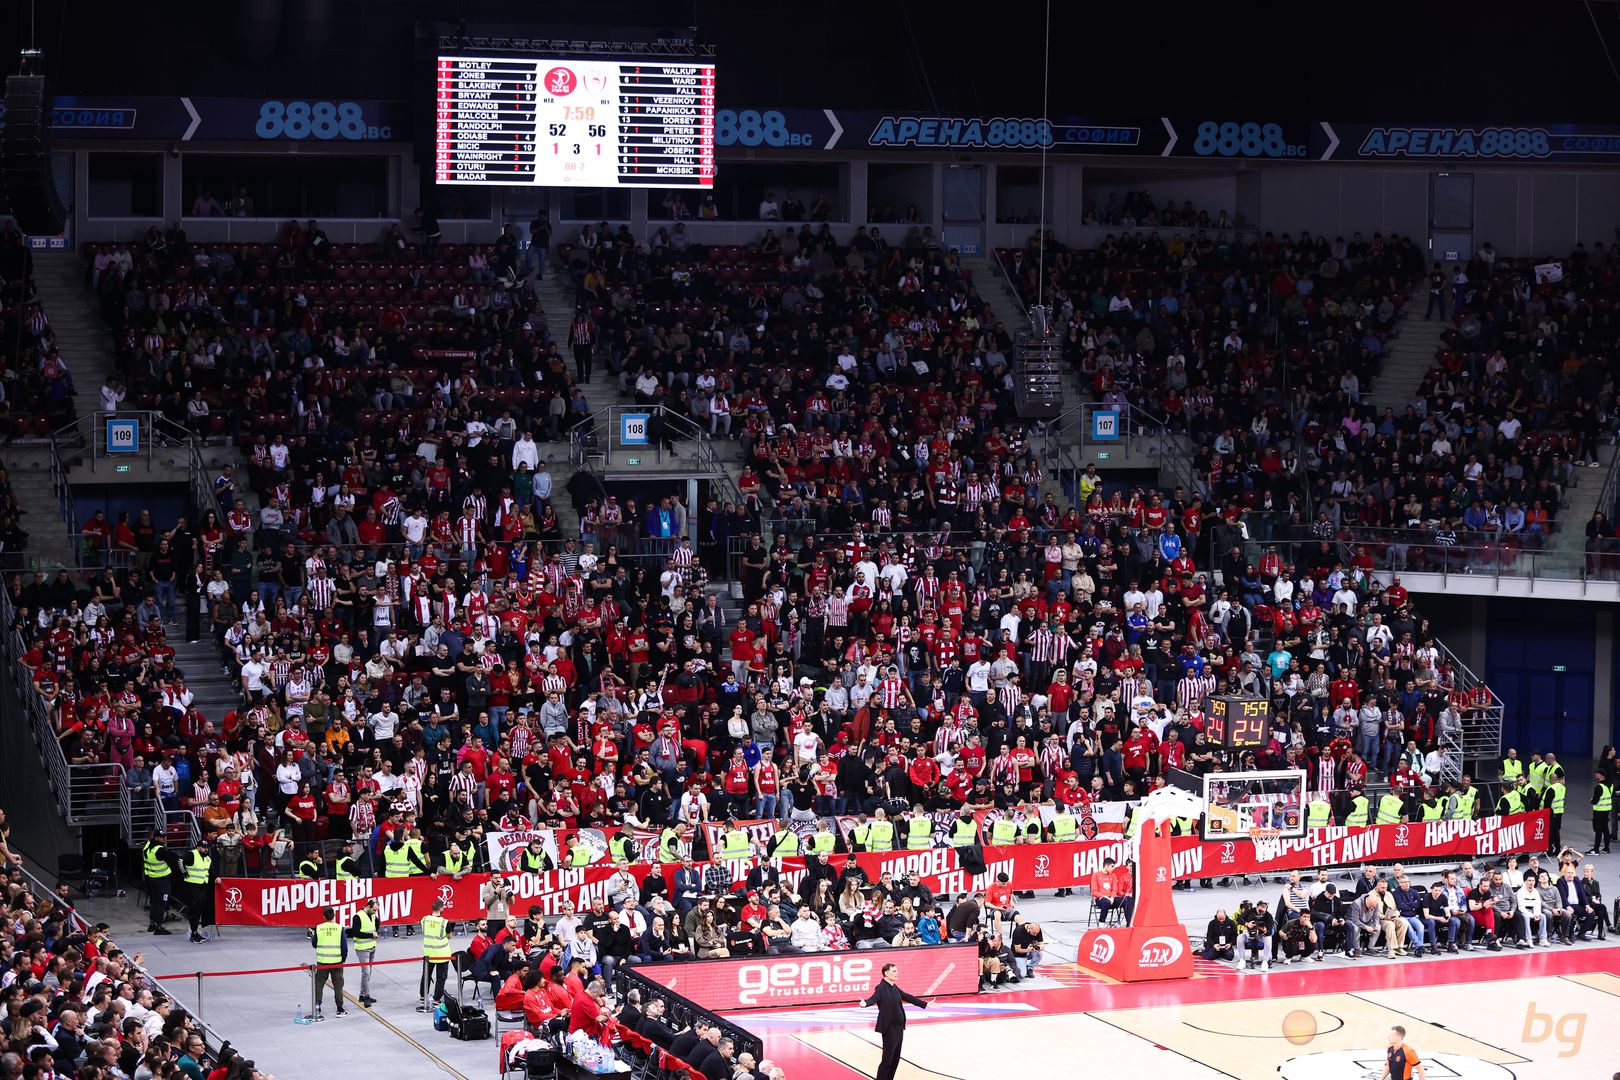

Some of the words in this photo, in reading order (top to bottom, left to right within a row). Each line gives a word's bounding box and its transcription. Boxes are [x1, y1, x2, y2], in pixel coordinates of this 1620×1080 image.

[563, 106, 594, 121] 7:59
[550, 124, 566, 136] 52
[588, 124, 606, 137] 56
[714, 110, 813, 147] 888.BG
[872, 120, 986, 144] АРЕНА
[987, 119, 1052, 145] 8888
[1065, 128, 1131, 142] СОФИЯ
[553, 142, 558, 154] 1
[573, 144, 580, 154] 3
[595, 144, 600, 155] 1
[1362, 130, 1479, 154] АРЕНА
[1480, 129, 1551, 155] 8888
[1562, 138, 1620, 151] СОФИ
[114, 430, 131, 441] 109
[627, 424, 643, 434] 108
[1098, 421, 1113, 430] 107
[1210, 700, 1226, 716] 7:59
[1240, 701, 1268, 716] 7:59
[1206, 717, 1224, 740] 24
[1233, 720, 1264, 741] 24
[1425, 819, 1483, 847] HAPOEL
[1475, 833, 1495, 855] TEL
[1498, 822, 1525, 854] AVIV
[1311, 842, 1338, 866] TEL
[1342, 828, 1380, 863] AVIV
[881, 848, 950, 881] HAPOEL
[938, 870, 967, 894] TEL
[972, 858, 1015, 892] AVIV
[262, 880, 340, 915] HAPOEL
[344, 878, 372, 902] IBI
[738, 956, 872, 1005] genie
[769, 985, 823, 997] Trusted
[829, 982, 870, 994] Cloud
